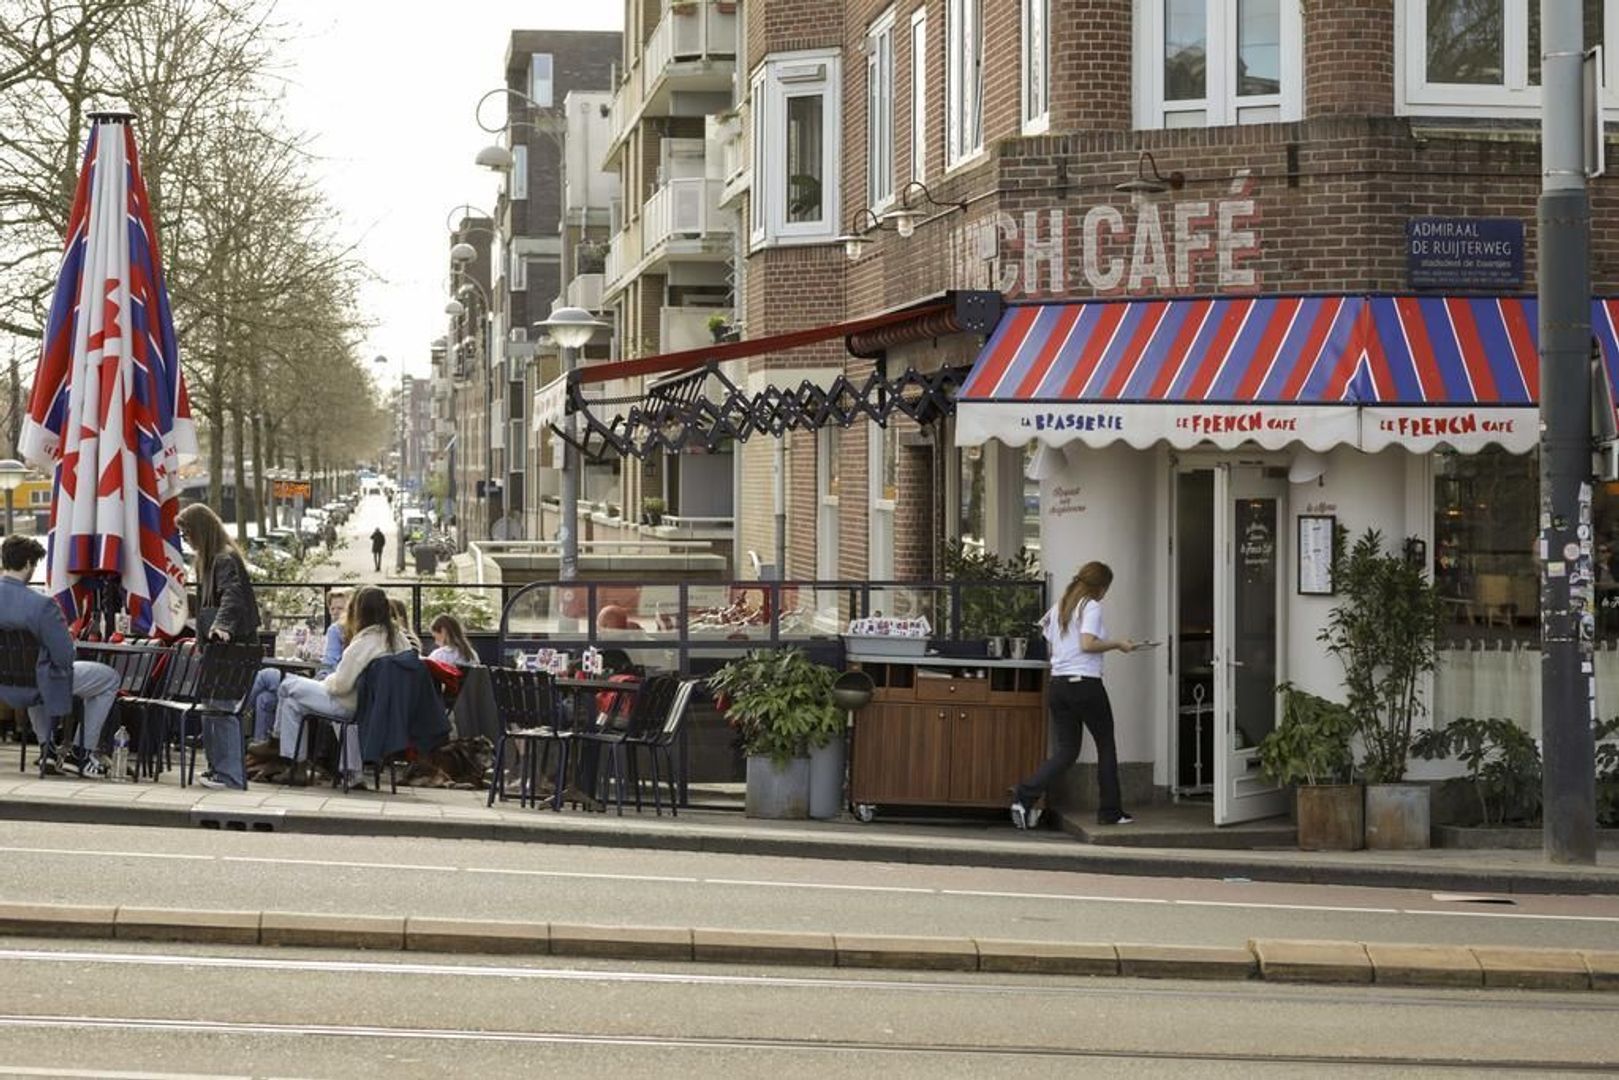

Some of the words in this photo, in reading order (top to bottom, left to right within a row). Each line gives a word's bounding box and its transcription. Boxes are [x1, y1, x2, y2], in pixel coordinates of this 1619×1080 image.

[1083, 169, 1259, 292] CAFÉ
[1412, 223, 1479, 237] ADMIRAAL
[1412, 240, 1429, 254] DE
[1433, 240, 1512, 258] RUIJTERWEG
[1021, 416, 1031, 427] LA
[1035, 412, 1123, 431] BRASSERIE
[1176, 417, 1188, 428] LE
[1192, 411, 1263, 433] FRENCH
[1267, 416, 1297, 430] CAFÉ
[1380, 420, 1395, 432] LE
[1398, 413, 1477, 437] FRENCH
[1482, 418, 1515, 433] CAFÉ
